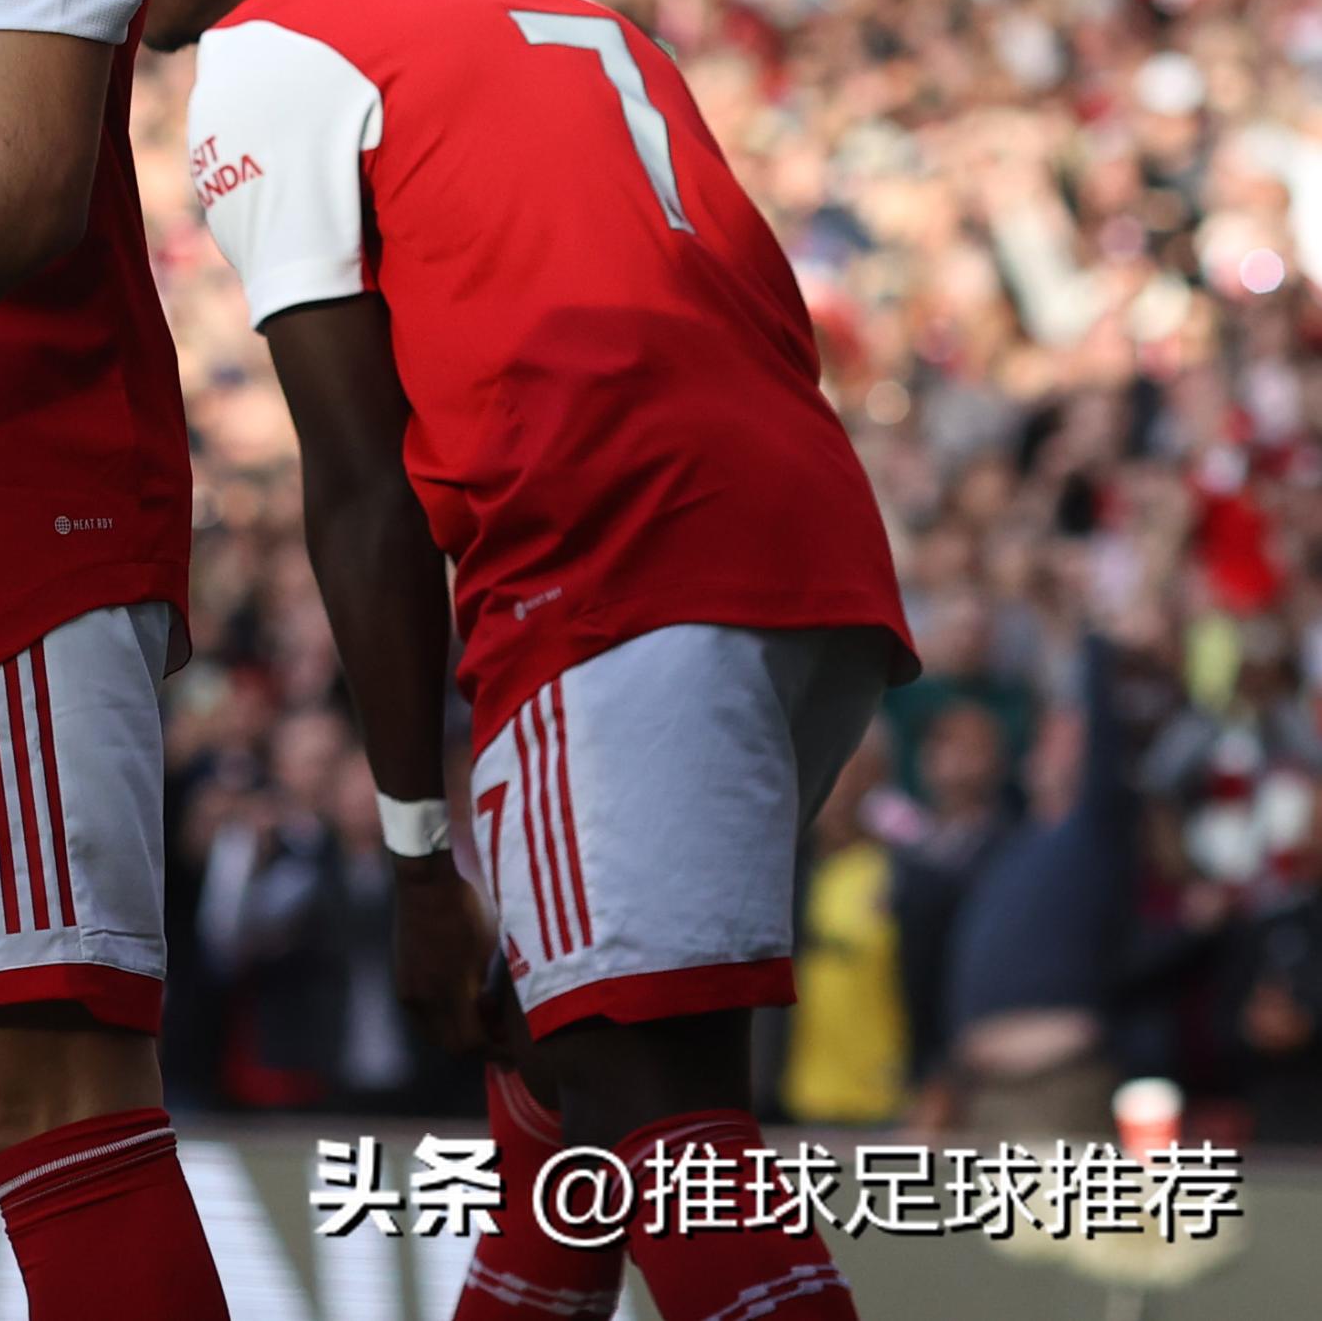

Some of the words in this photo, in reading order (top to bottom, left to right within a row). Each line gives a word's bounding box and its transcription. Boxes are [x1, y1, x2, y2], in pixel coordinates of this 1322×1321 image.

[199, 154, 264, 208] NDA
[508, 9, 697, 237] 7
[476, 780, 509, 908] 7
